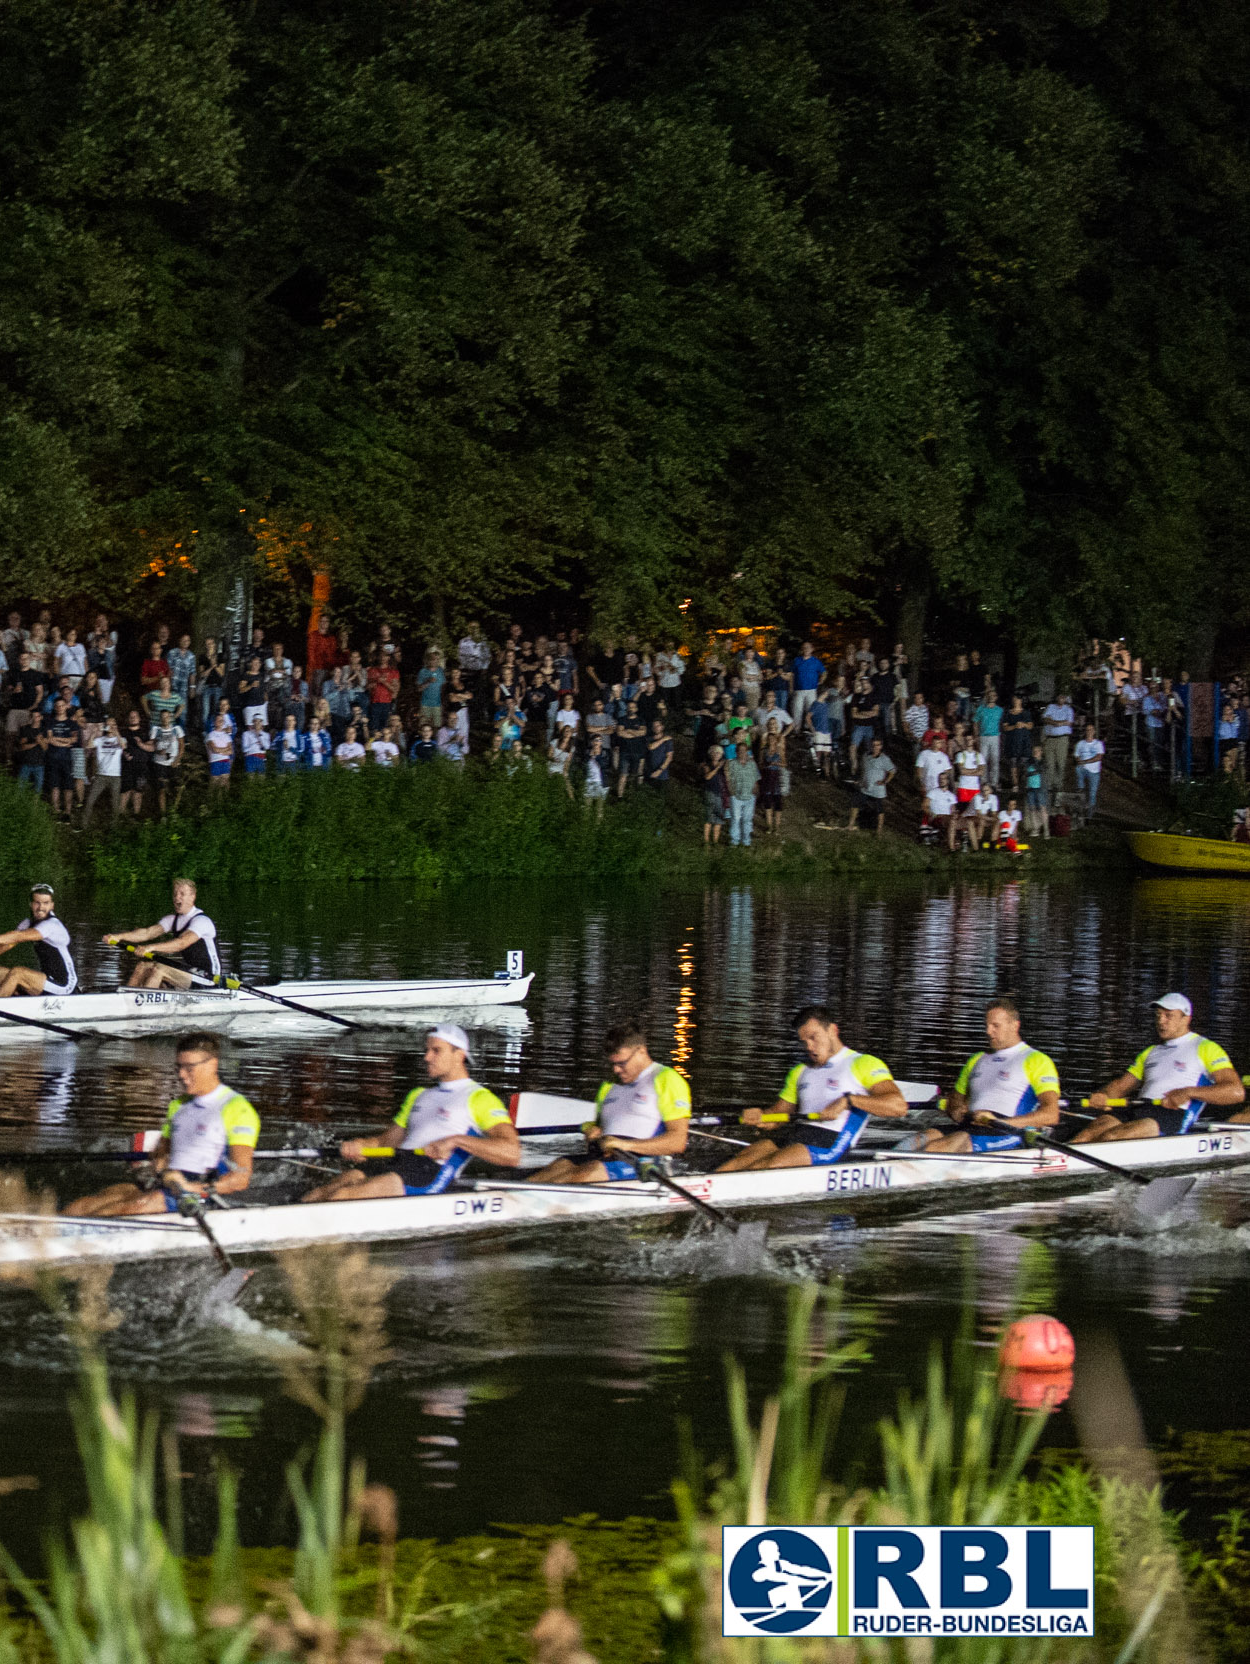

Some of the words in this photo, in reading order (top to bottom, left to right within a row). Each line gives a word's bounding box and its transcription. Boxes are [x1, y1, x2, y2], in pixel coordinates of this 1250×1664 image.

[511, 952, 519, 970] 5
[146, 993, 169, 1003] RBL
[1197, 1136, 1234, 1153] DWB
[827, 1166, 893, 1191] BERLIN
[454, 1197, 504, 1215] DWB
